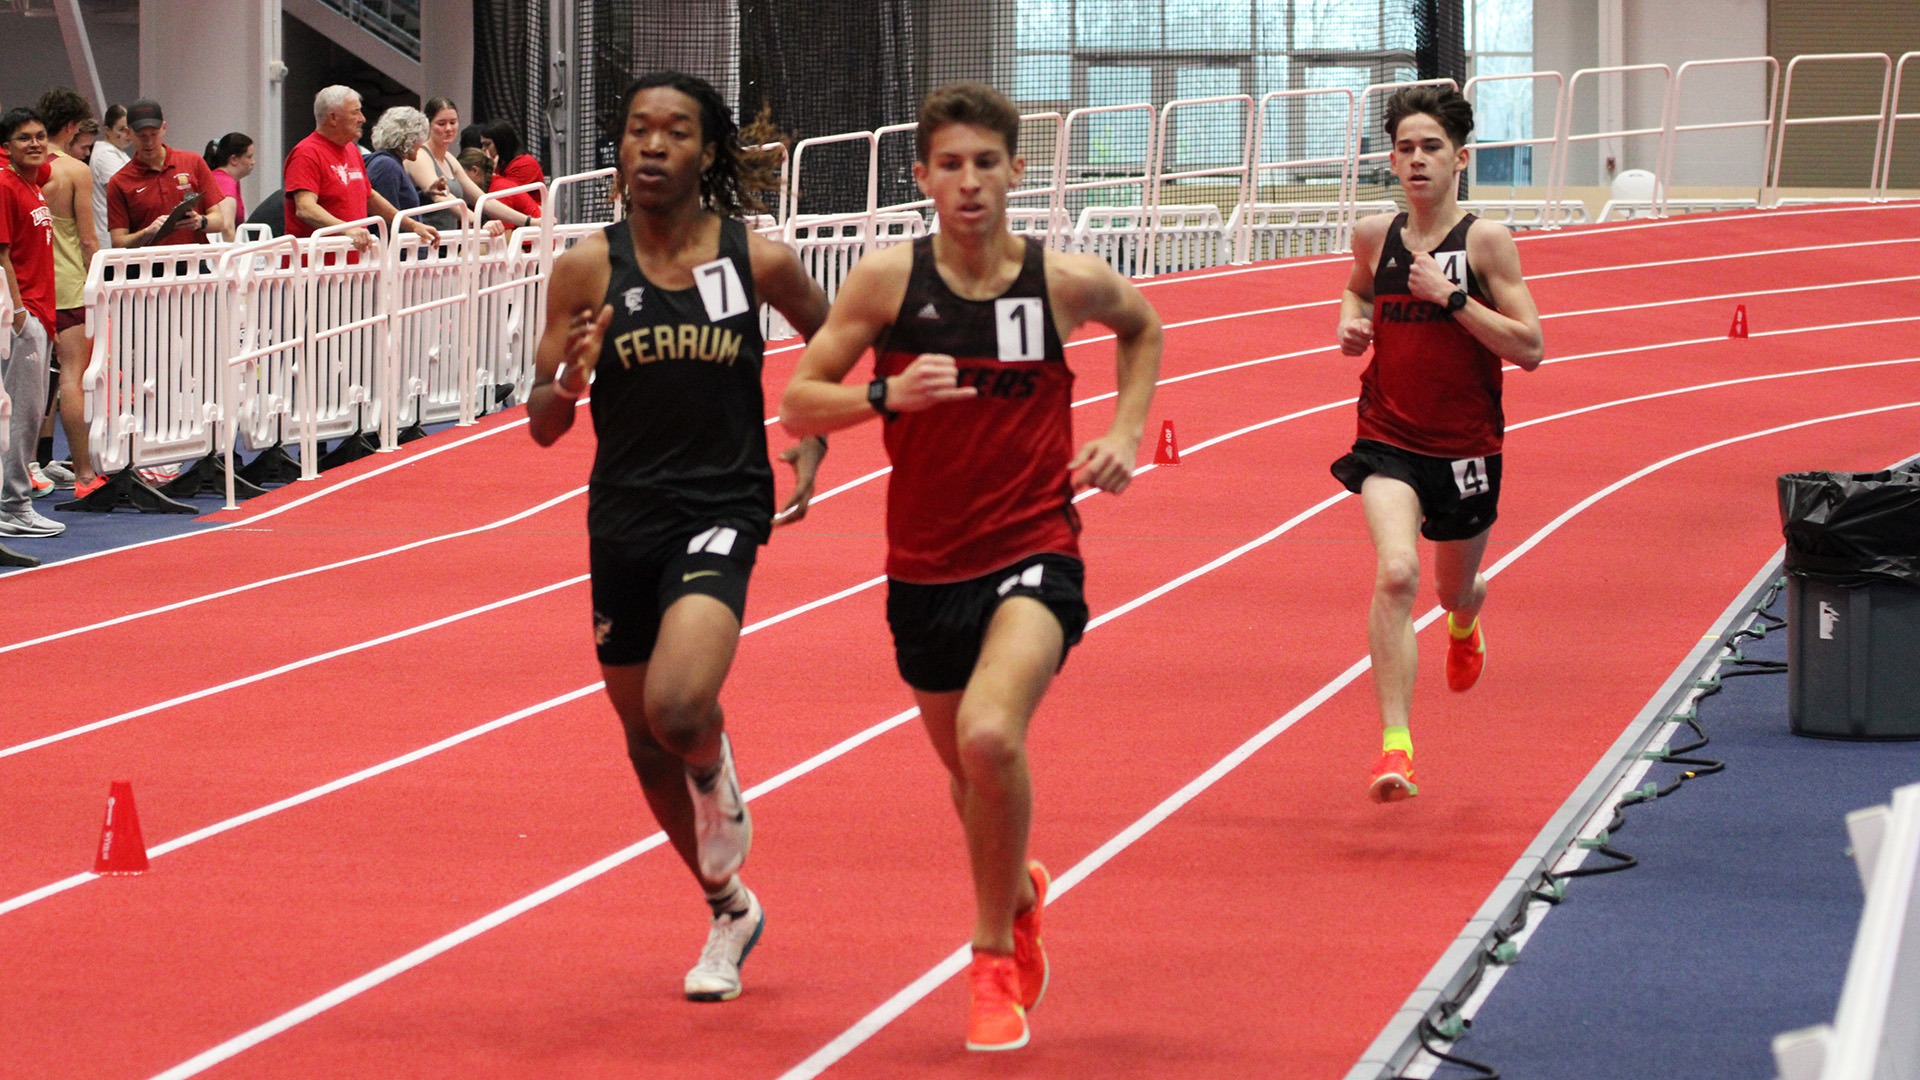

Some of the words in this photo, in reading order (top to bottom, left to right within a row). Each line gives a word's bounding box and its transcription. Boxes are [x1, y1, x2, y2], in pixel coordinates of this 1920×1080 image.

[703, 265, 729, 314] 7
[1443, 254, 1461, 285] 4
[1010, 304, 1029, 356] 1
[1380, 301, 1454, 324] PACER
[614, 323, 743, 370] FERRUM
[1463, 460, 1483, 493] 4
